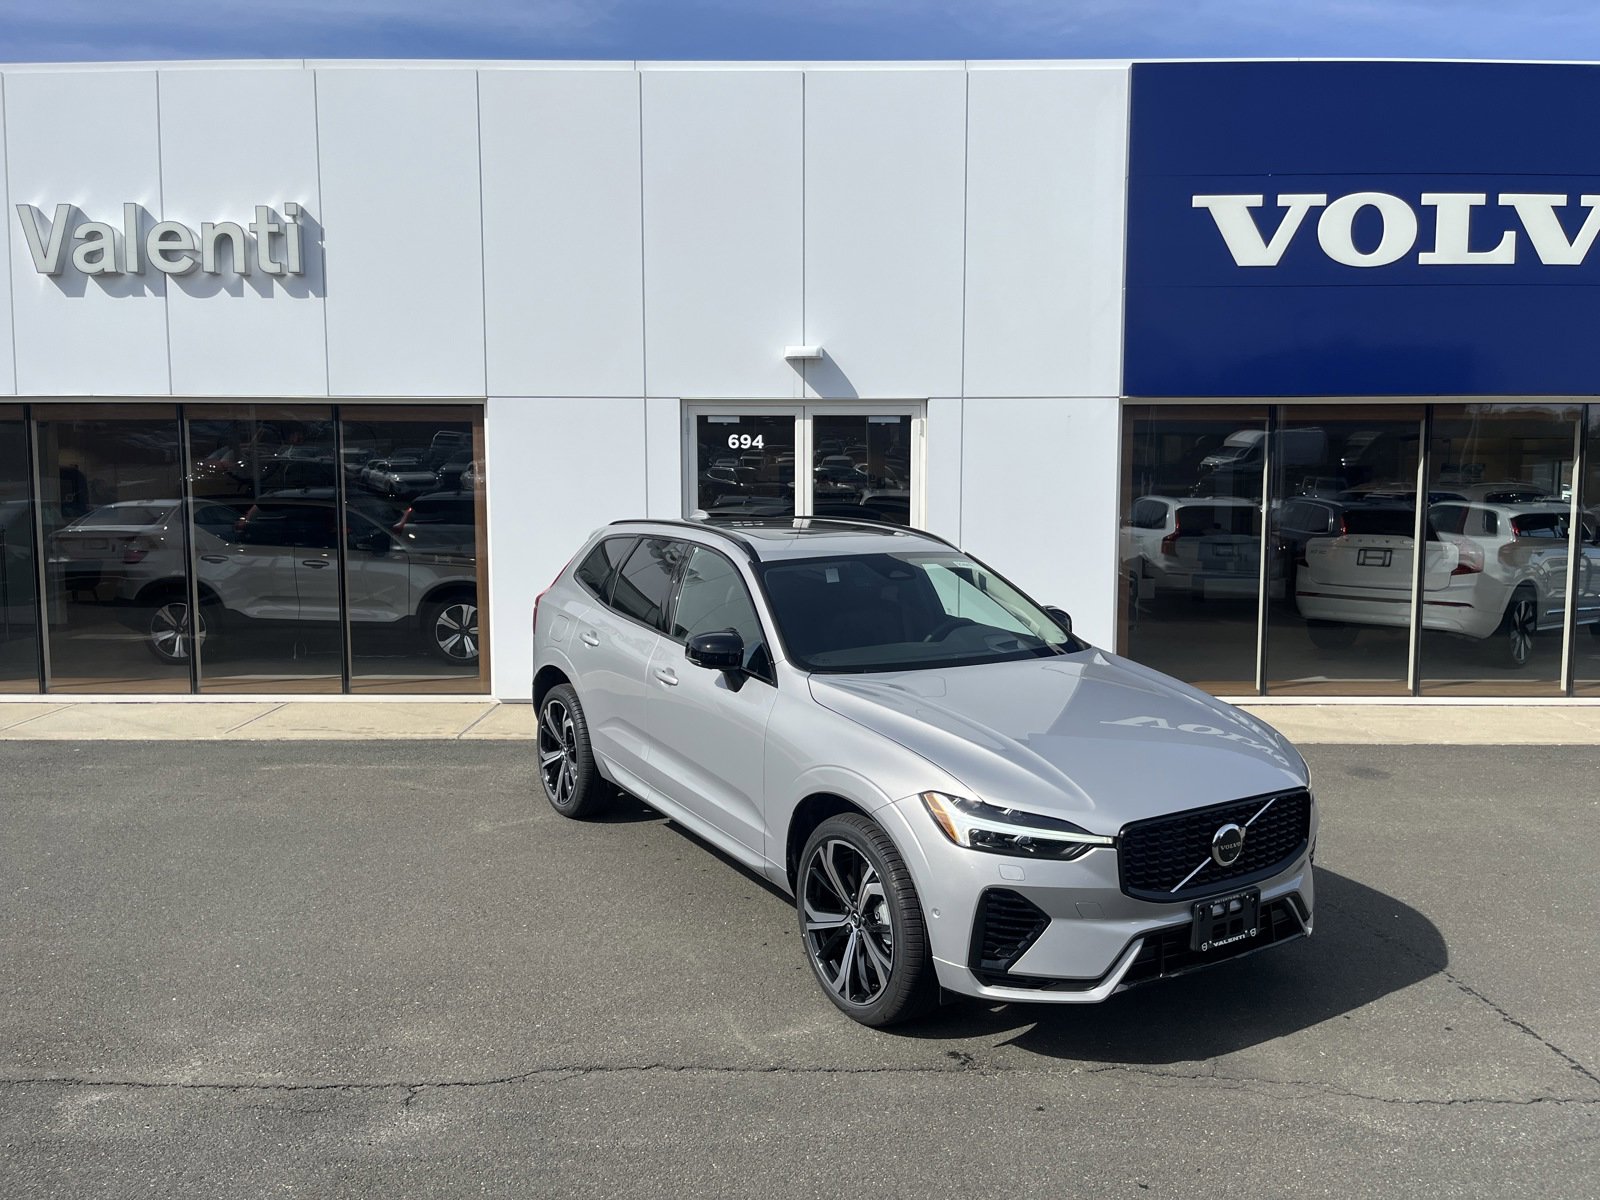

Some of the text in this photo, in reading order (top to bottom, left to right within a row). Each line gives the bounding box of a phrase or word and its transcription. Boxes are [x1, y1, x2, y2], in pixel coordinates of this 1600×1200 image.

[15, 202, 302, 274] Valenti
[1192, 191, 1600, 267] VOLV
[728, 434, 764, 449] 694
[1213, 934, 1246, 947] VALENTI
